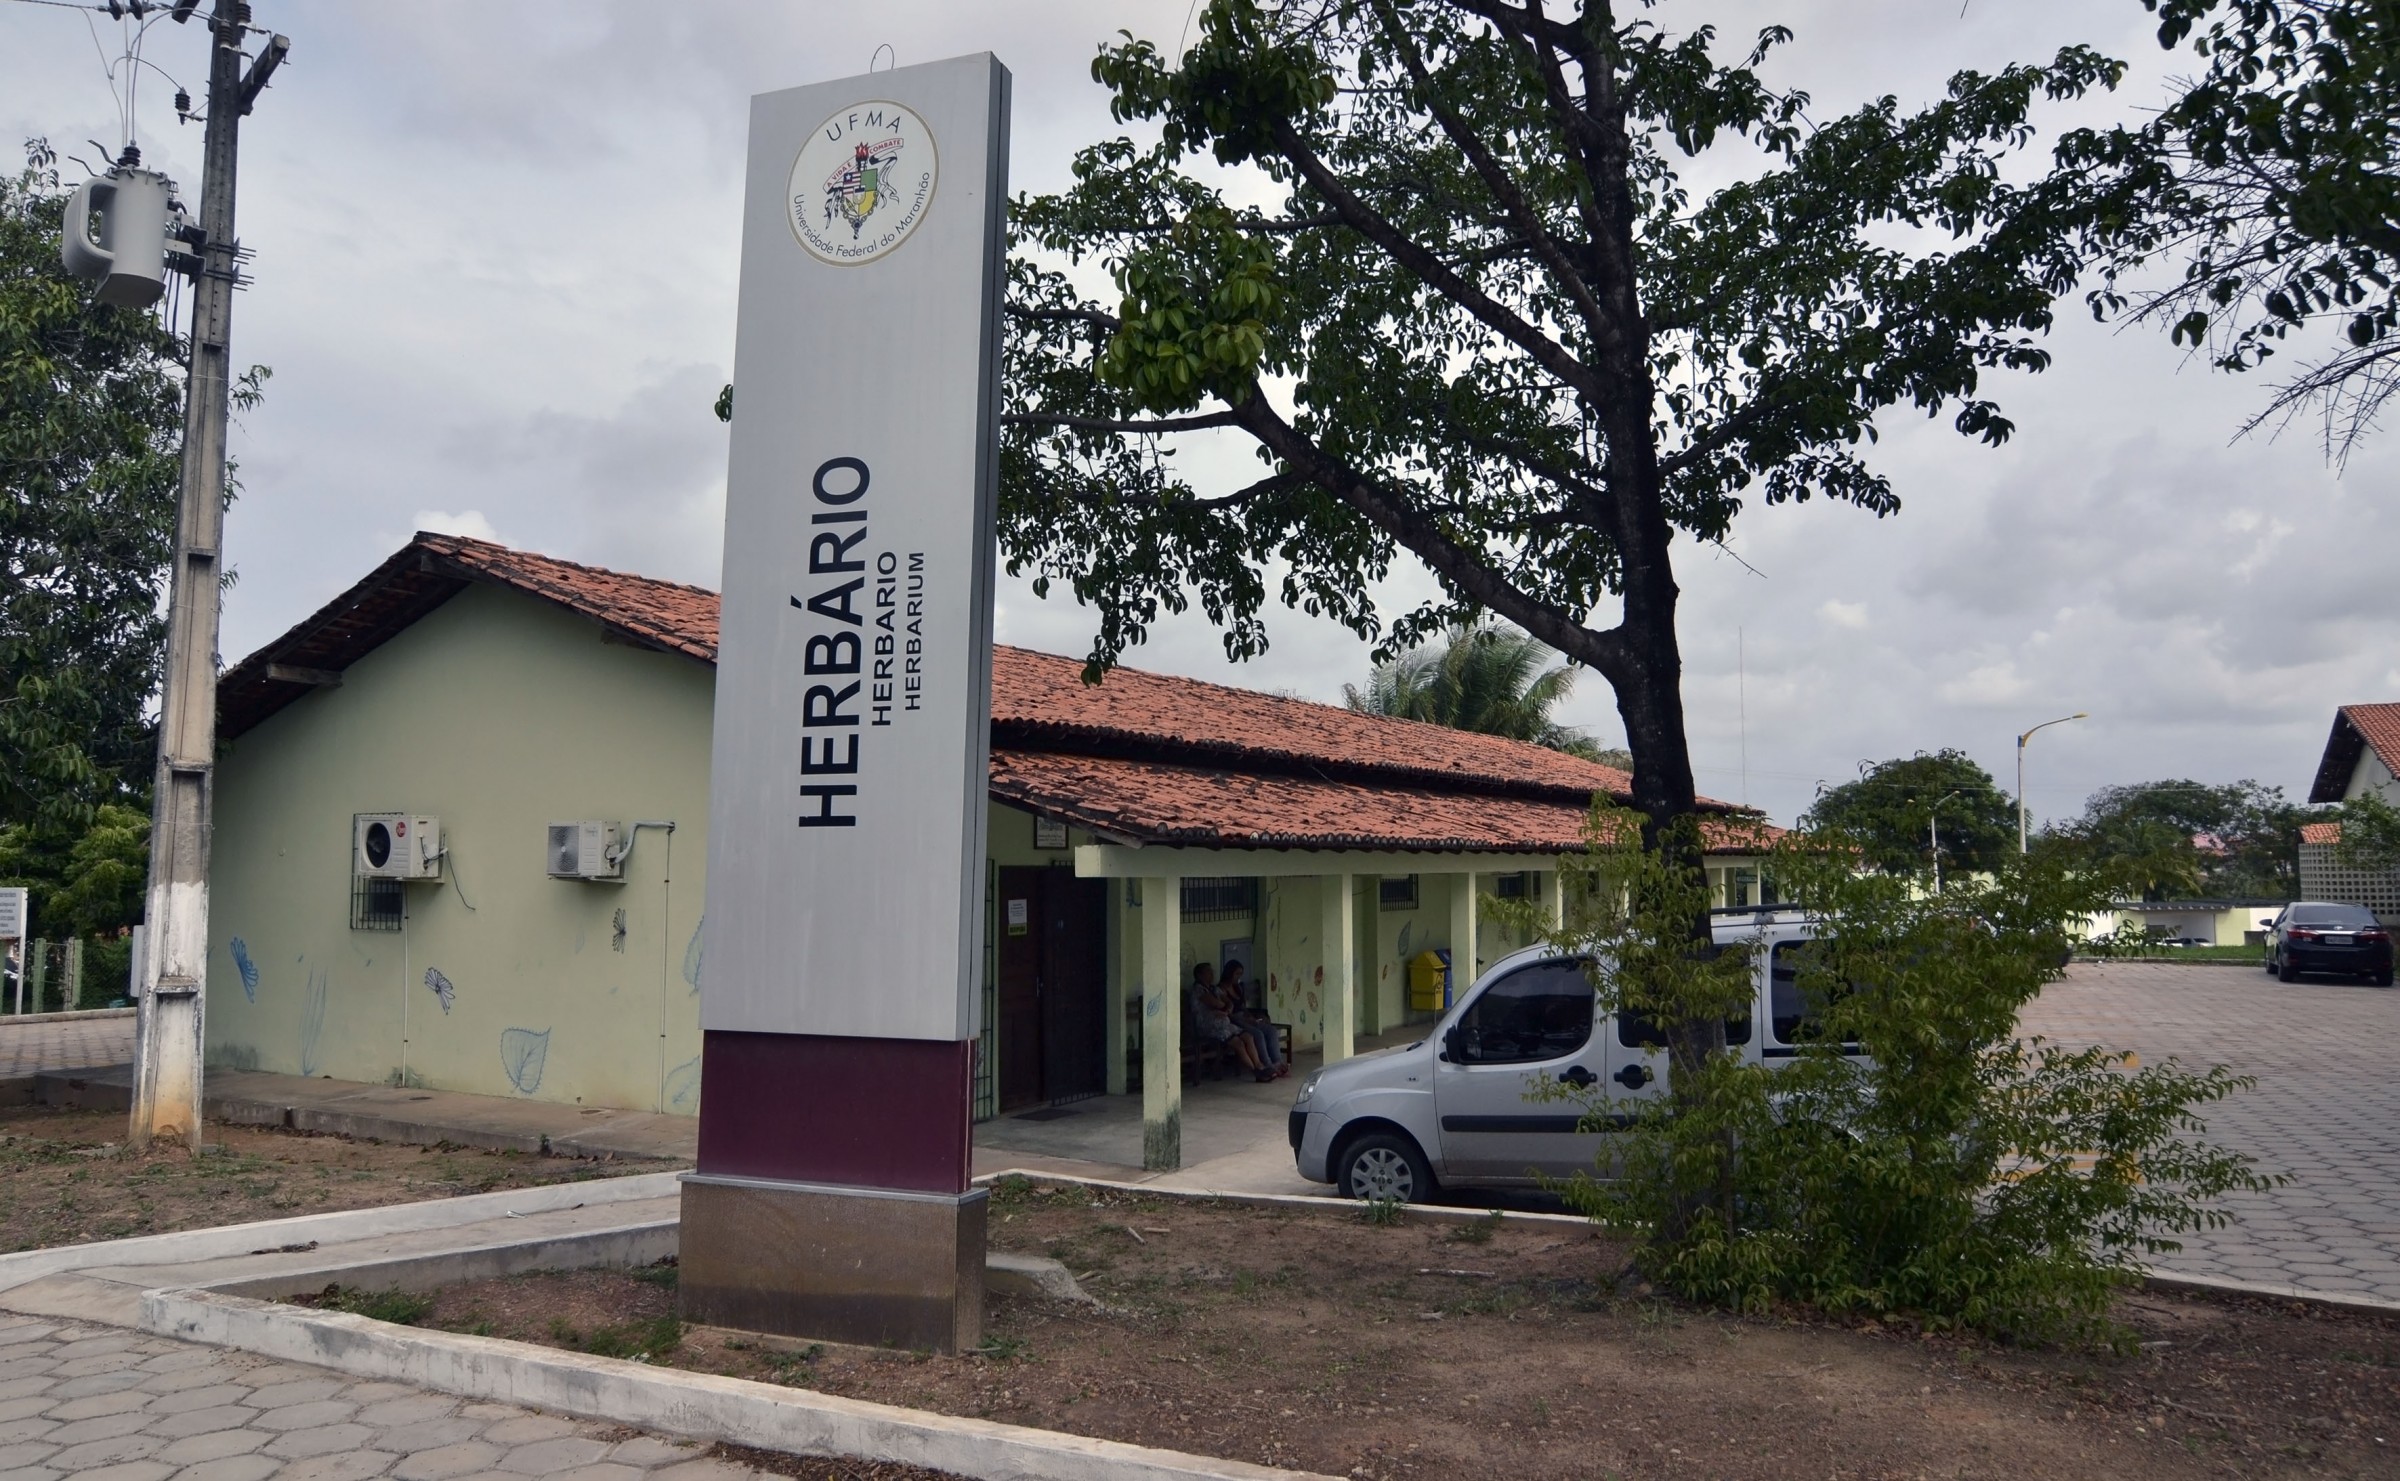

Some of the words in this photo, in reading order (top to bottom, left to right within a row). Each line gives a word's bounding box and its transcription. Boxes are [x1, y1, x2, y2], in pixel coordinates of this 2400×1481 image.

[826, 110, 901, 141] UFMA
[832, 167, 848, 180] VIDA
[868, 140, 901, 155] COMBATE
[794, 194, 834, 254] Universidade
[836, 239, 878, 258] Federal
[880, 233, 896, 247] do
[895, 172, 930, 235] Maranhão
[790, 456, 870, 827] HERBÁRIO
[872, 551, 897, 726] HERBARIO
[905, 552, 924, 711] HERBARIUM
